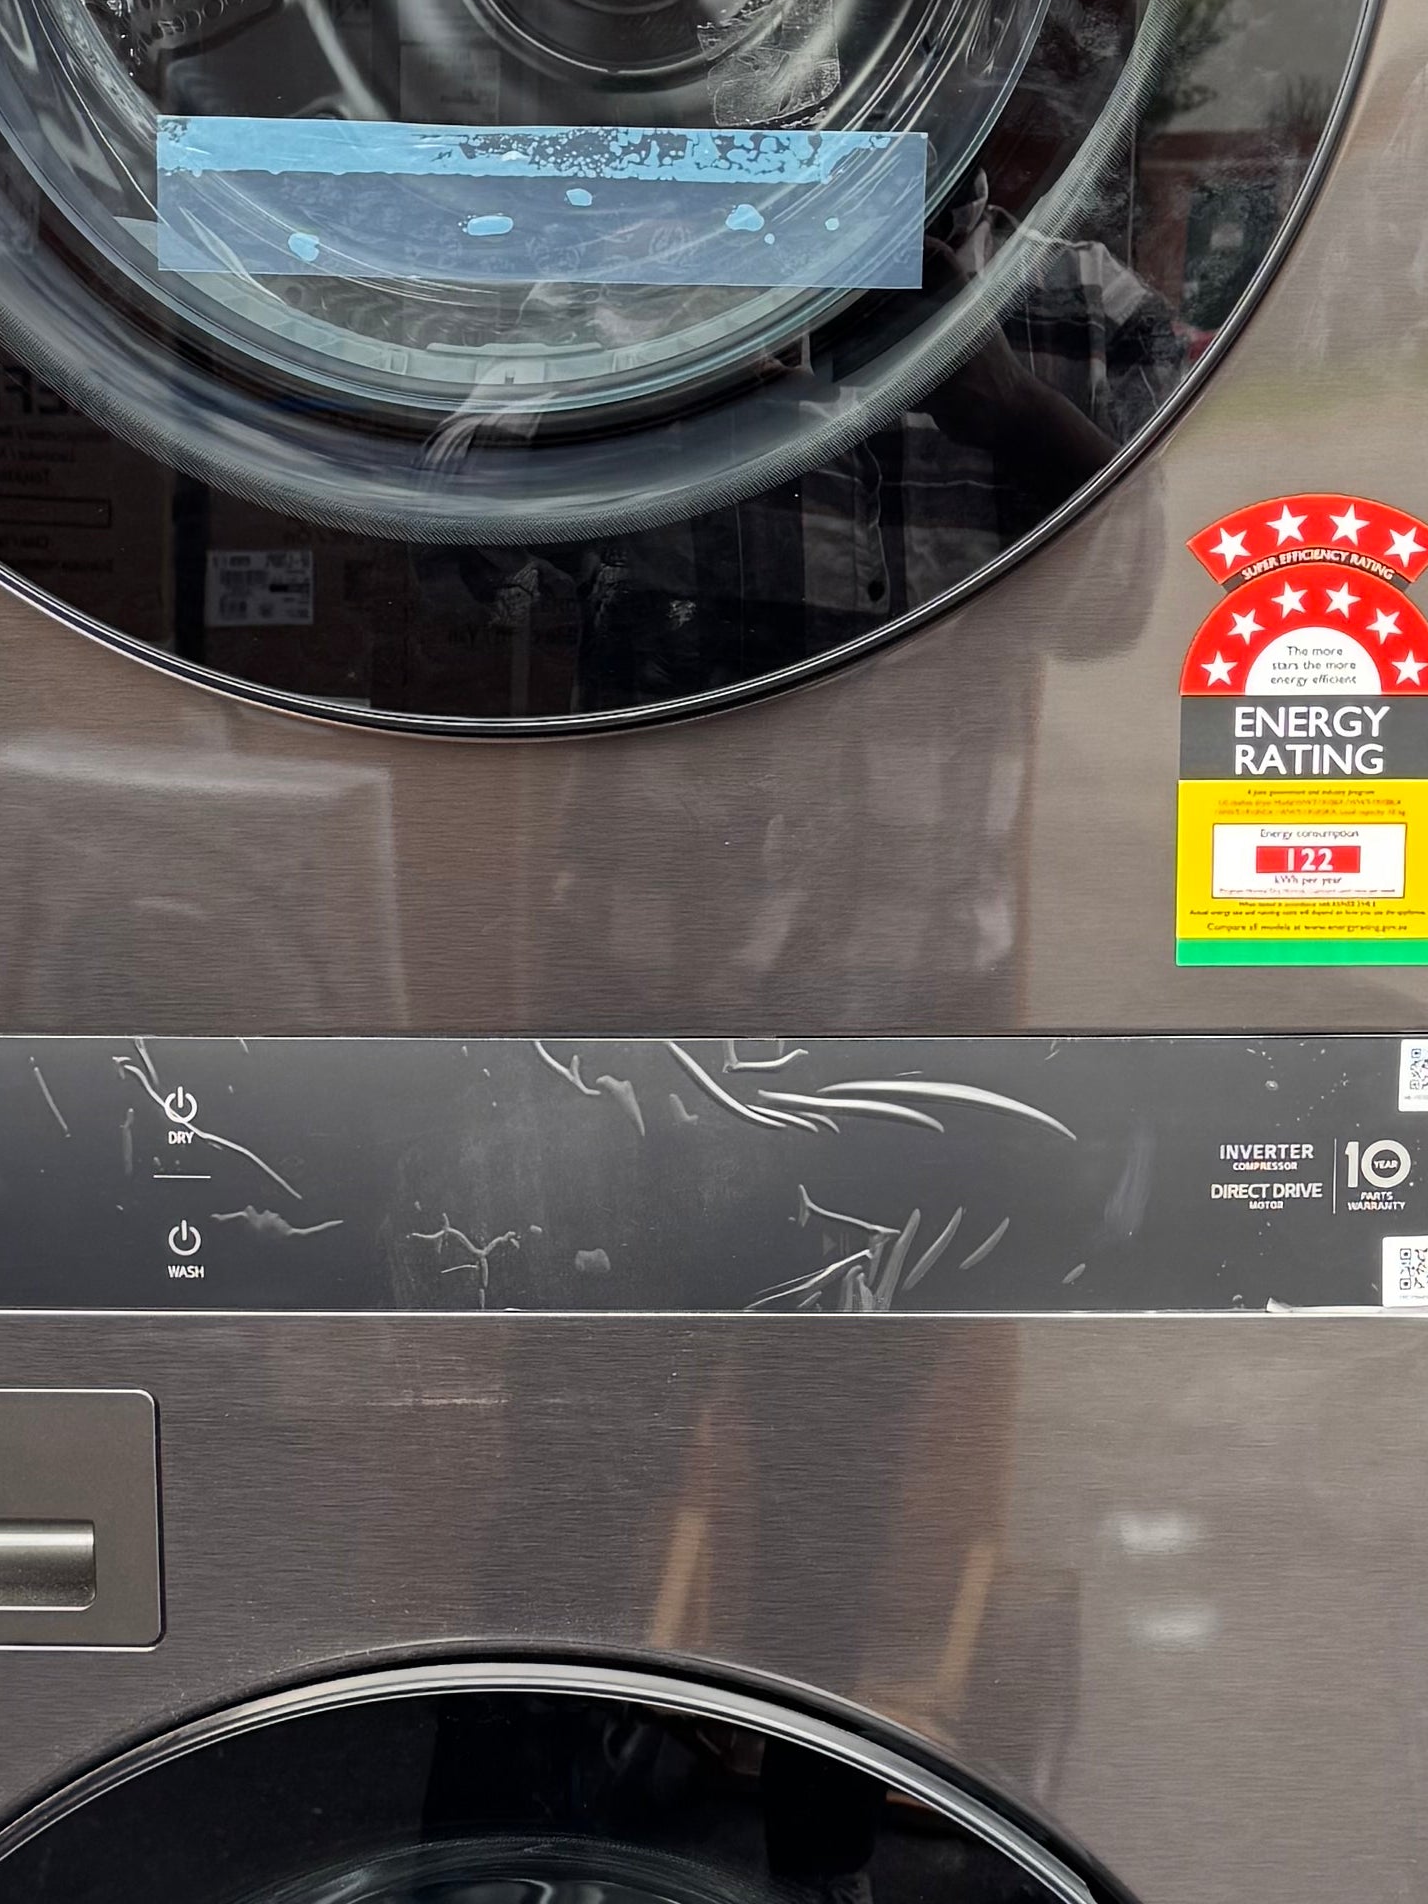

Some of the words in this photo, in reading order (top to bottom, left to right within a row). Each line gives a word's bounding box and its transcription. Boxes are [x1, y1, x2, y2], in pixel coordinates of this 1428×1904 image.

[1287, 646, 1308, 655] The
[1304, 661, 1321, 669] the
[1271, 676, 1308, 686] energy
[1234, 705, 1390, 738] ENERGY
[1234, 744, 1384, 776] RATING
[1288, 848, 1333, 871] 122
[168, 1131, 194, 1144] DRY
[1220, 1144, 1314, 1160] INVERTER
[1233, 1161, 1298, 1171] COMPRESSOR
[1345, 1140, 1411, 1188] 10
[1374, 1161, 1398, 1169] YEAR
[1211, 1183, 1271, 1199] DIRECT
[1273, 1183, 1323, 1198] DRIVE
[1360, 1192, 1393, 1201] PARTS
[1249, 1201, 1283, 1210] MOTOR
[1348, 1202, 1406, 1211] WARRANTY
[168, 1265, 205, 1278] WASH
